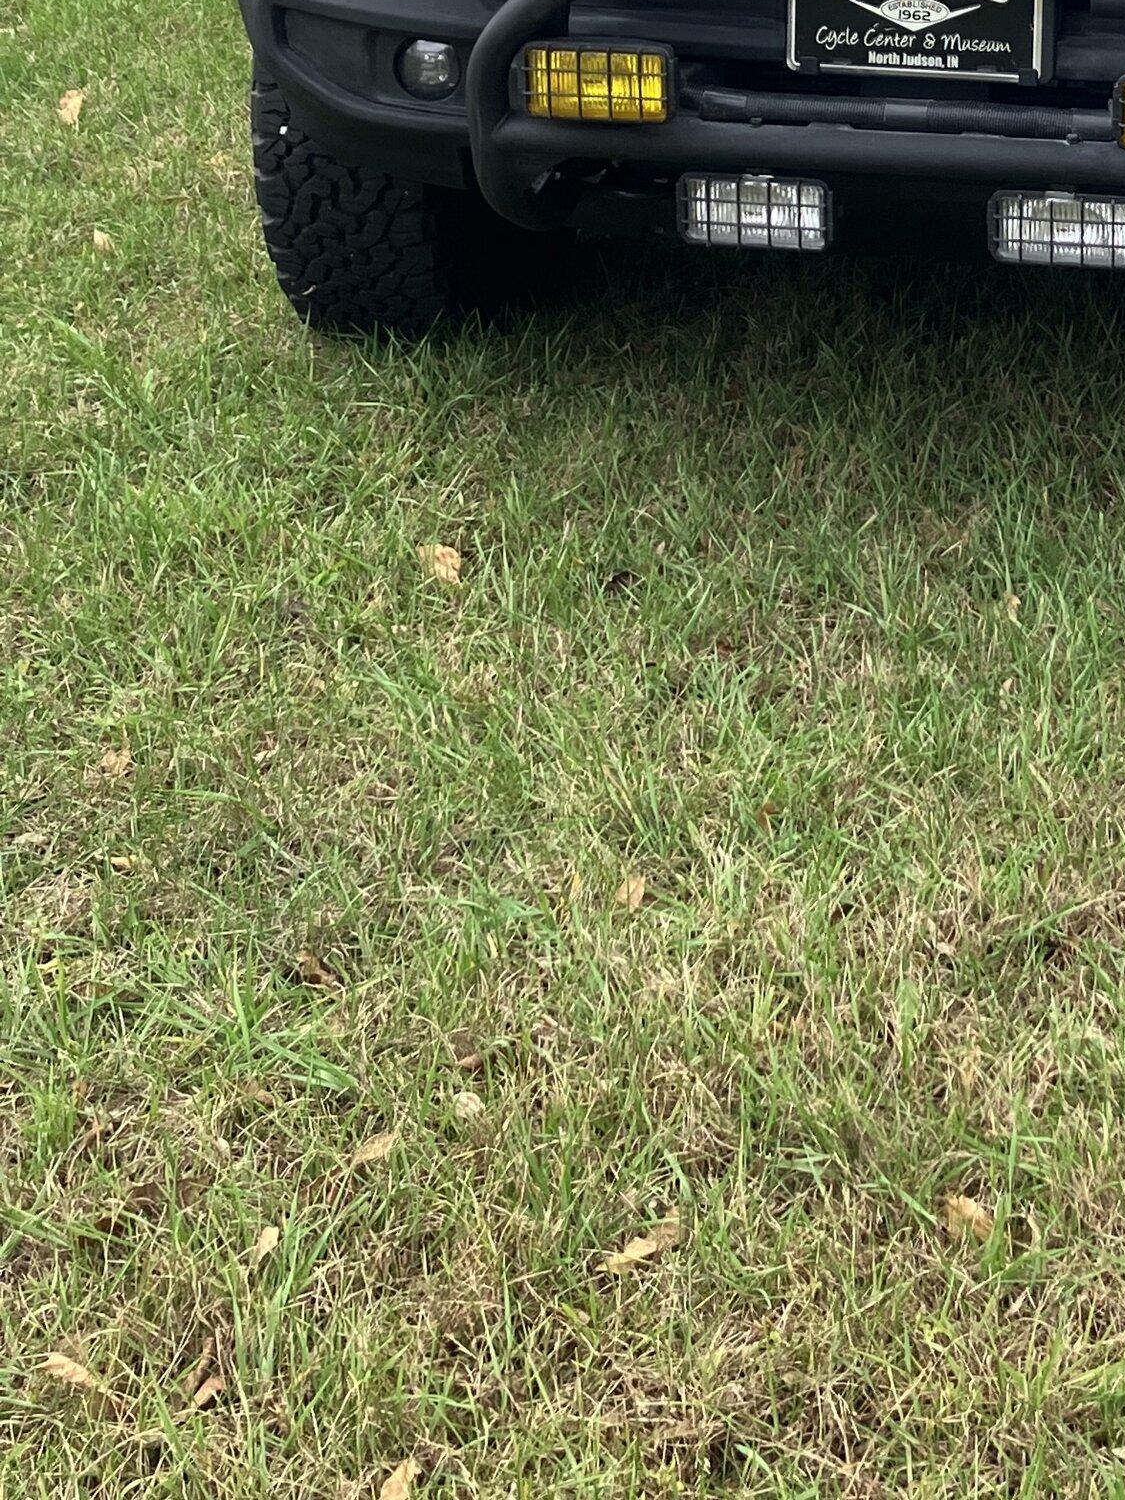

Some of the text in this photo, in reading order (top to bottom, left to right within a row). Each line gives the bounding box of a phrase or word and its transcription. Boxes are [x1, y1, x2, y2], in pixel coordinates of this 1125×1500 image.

[888, 0, 942, 14] ESTABLISHED
[898, 9, 931, 22] 1962
[816, 24, 1011, 52] Cycle Center & Museum
[868, 51, 959, 68] North Judson, IN
